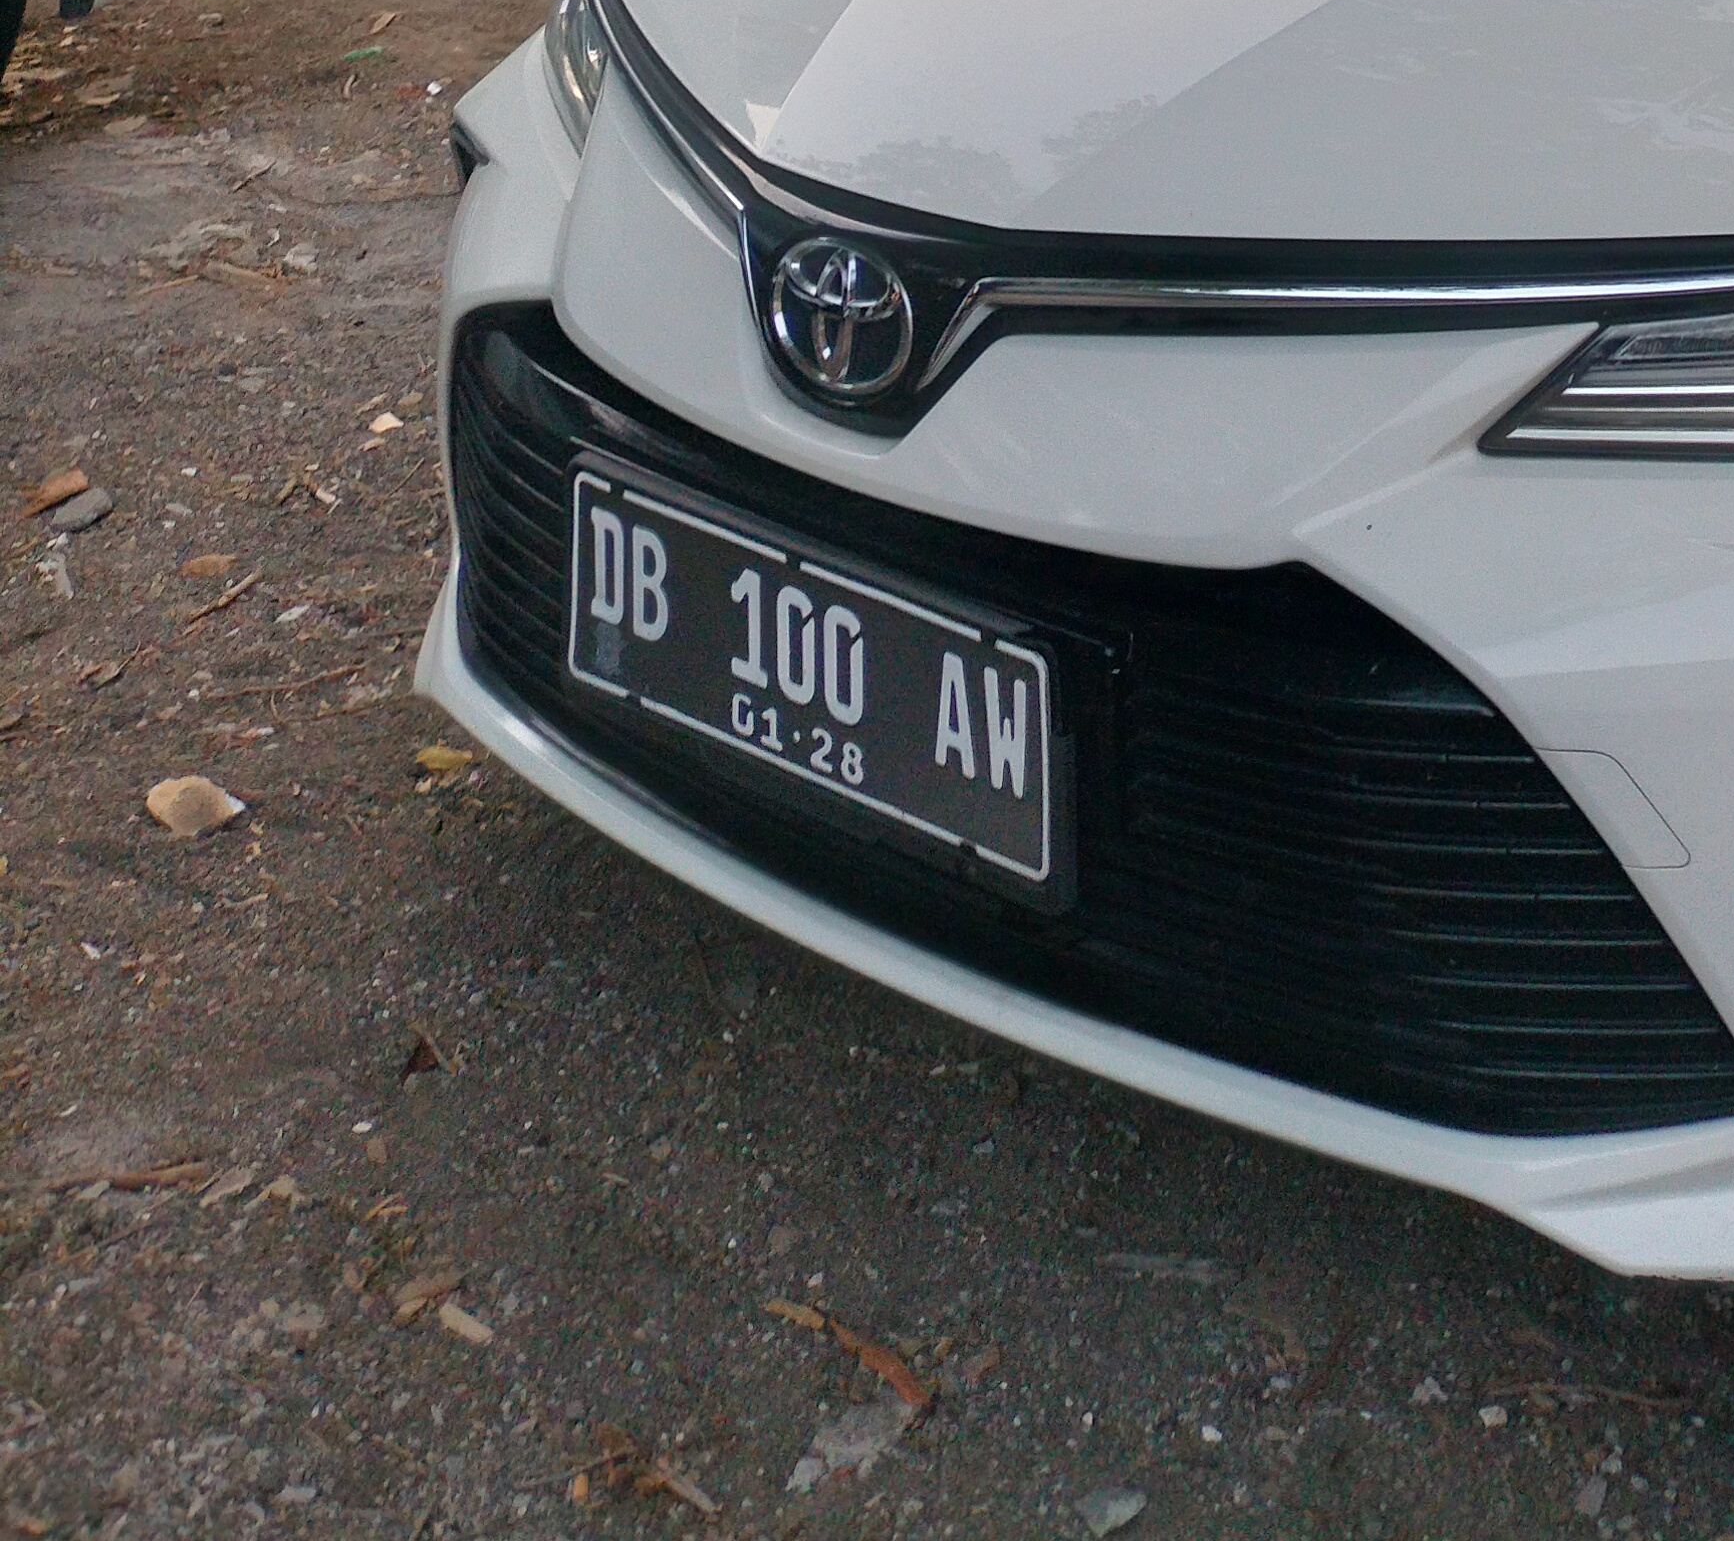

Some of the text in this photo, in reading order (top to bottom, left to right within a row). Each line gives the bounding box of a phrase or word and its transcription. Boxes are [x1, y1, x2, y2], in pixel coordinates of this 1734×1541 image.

[589, 506, 1028, 800] DB 100 AW
